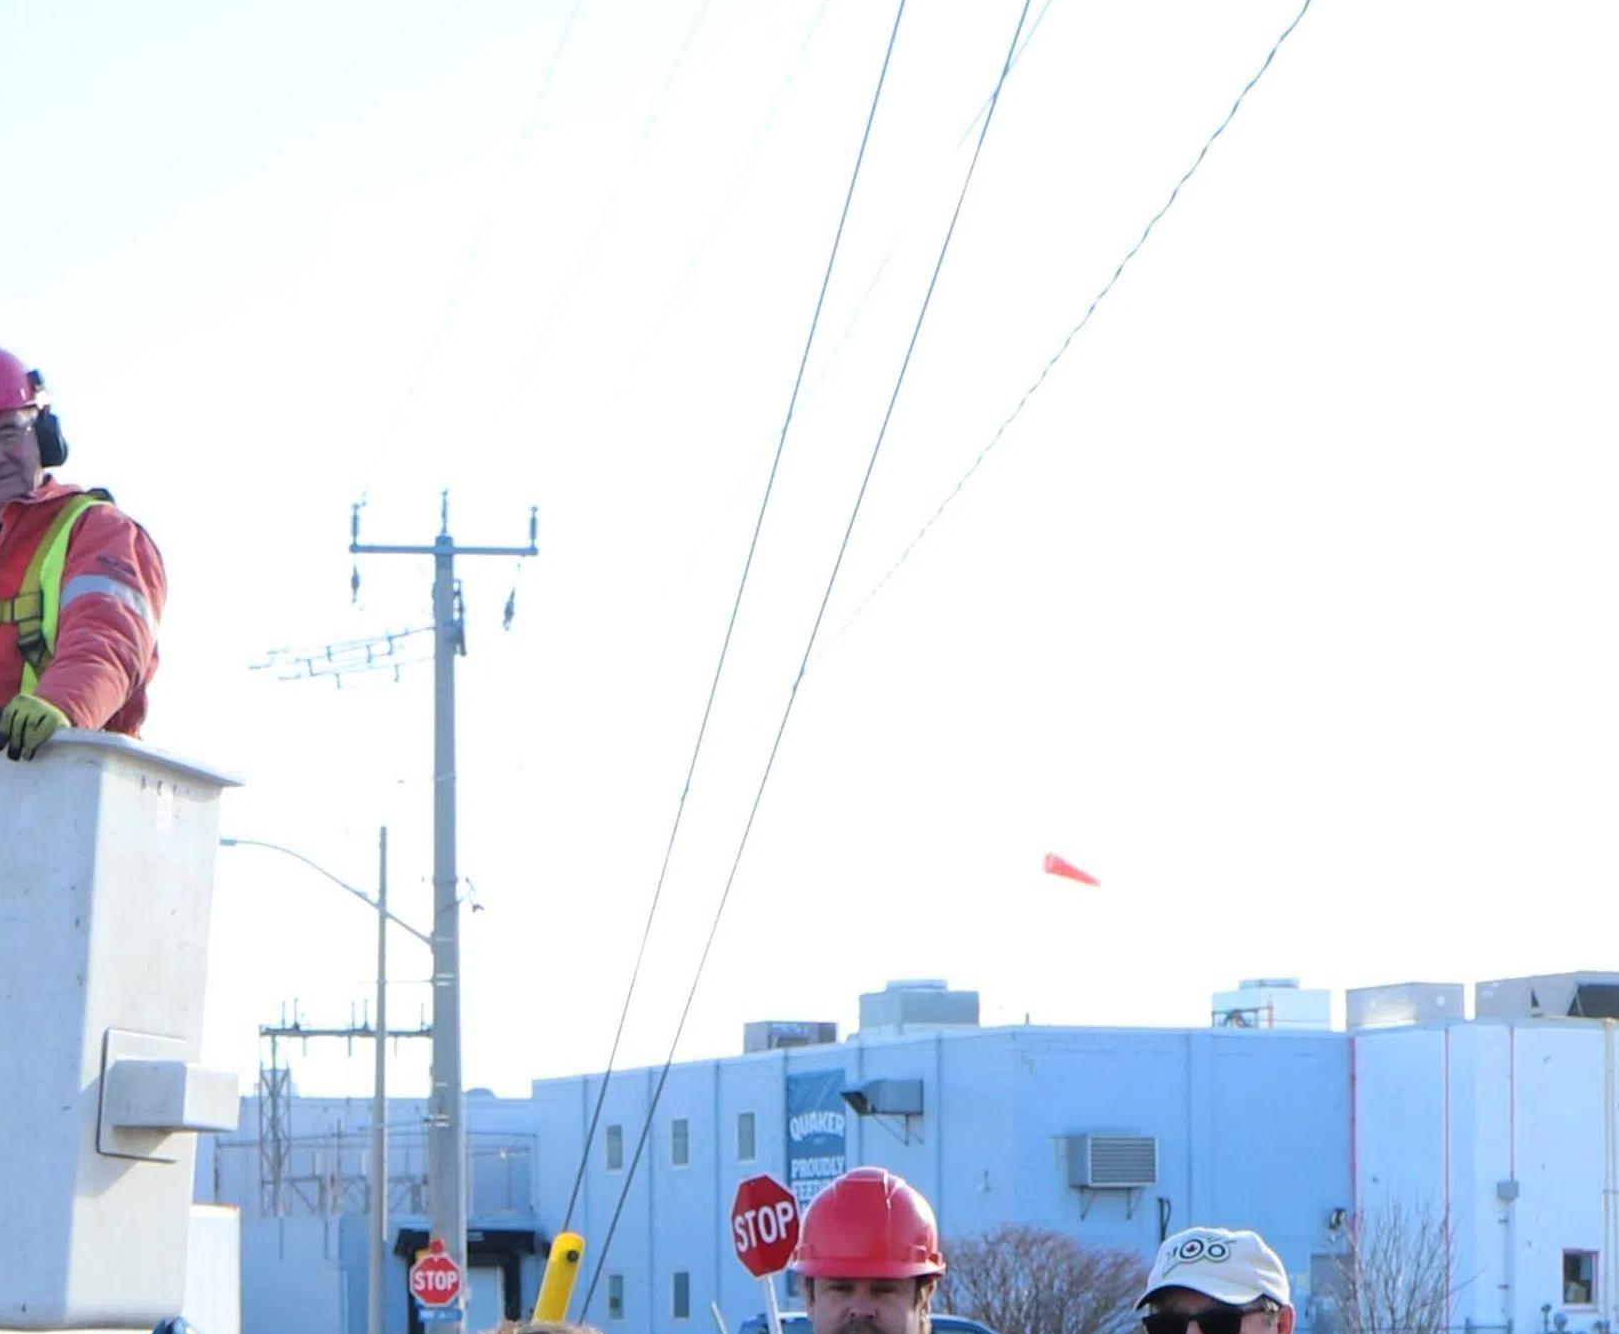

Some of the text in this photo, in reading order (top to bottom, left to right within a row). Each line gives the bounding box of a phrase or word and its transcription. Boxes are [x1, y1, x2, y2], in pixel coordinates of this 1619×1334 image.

[790, 1111, 845, 1142] QUAKER
[791, 1156, 845, 1178] PROUDLY
[734, 1200, 794, 1253] STOP
[414, 1270, 458, 1291] STOP
